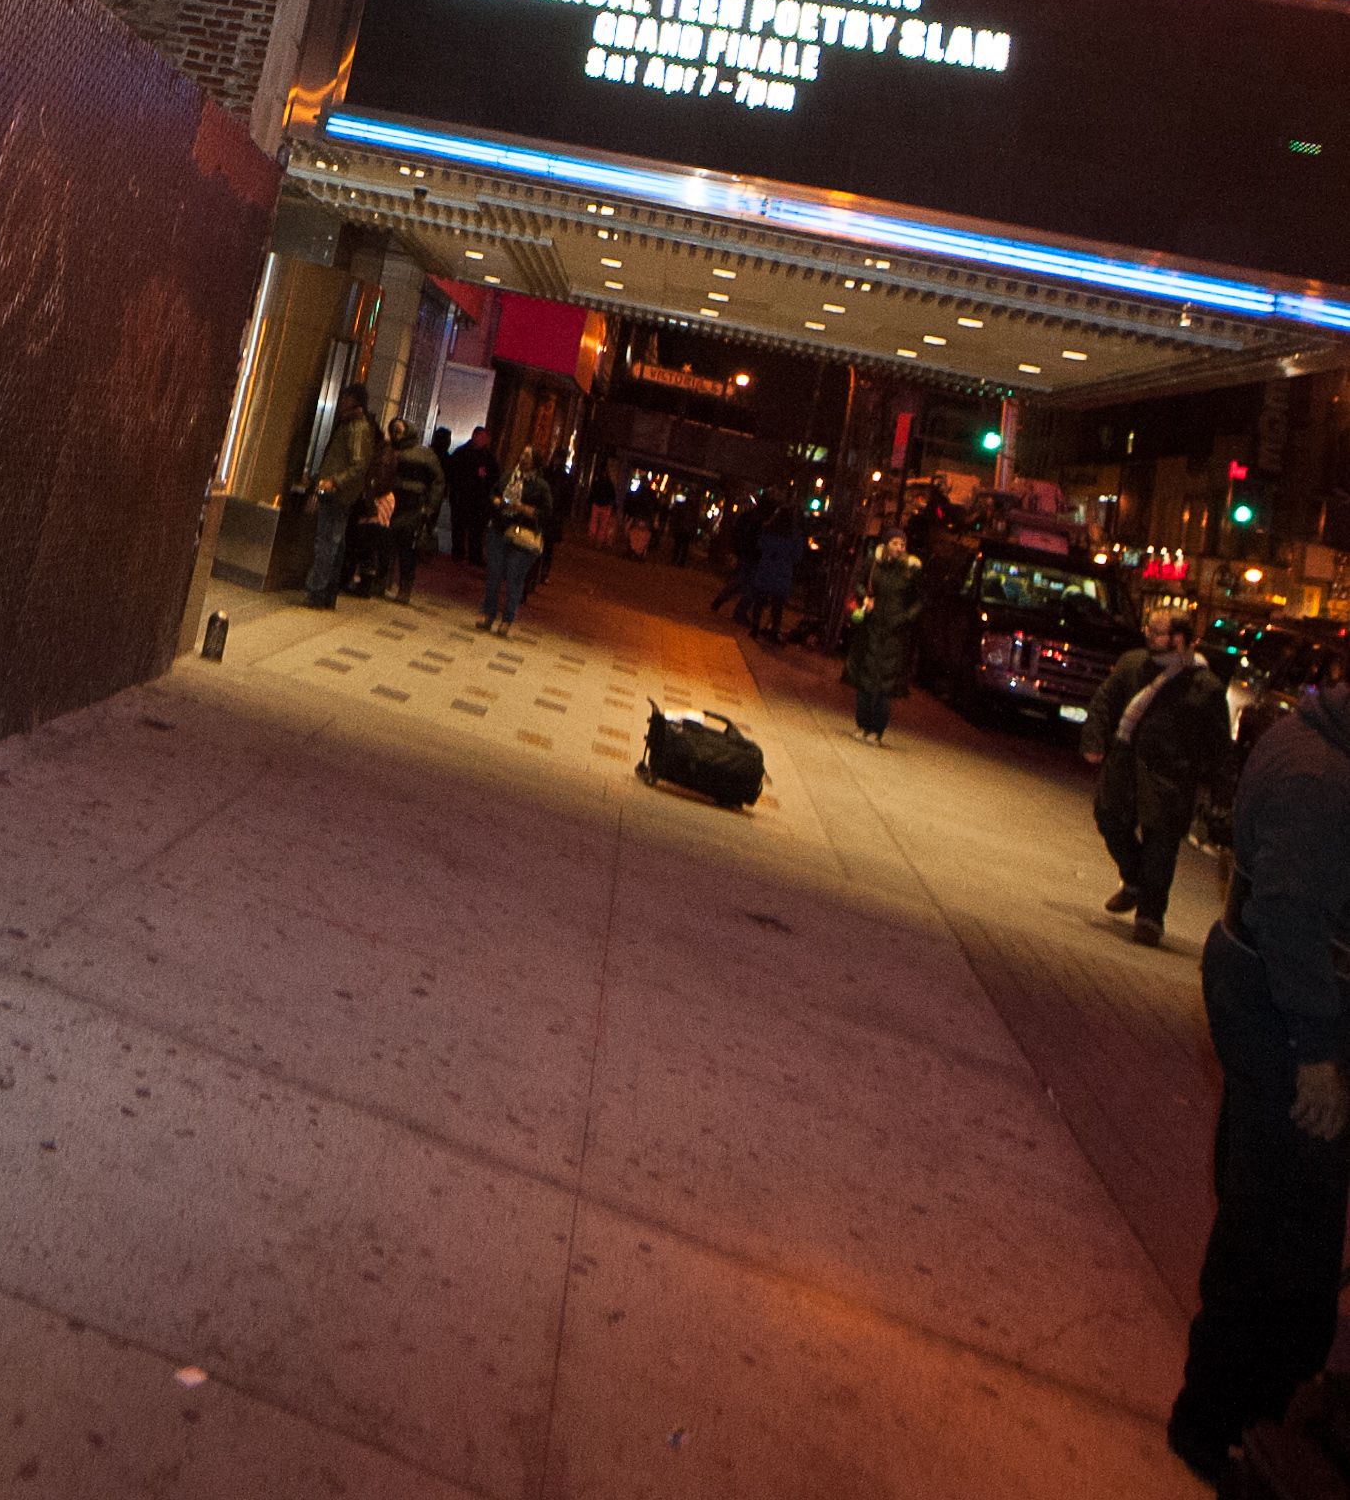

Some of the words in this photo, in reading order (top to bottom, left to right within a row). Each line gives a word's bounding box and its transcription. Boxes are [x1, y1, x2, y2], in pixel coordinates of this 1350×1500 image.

[584, 46, 638, 85] Sat
[643, 56, 699, 95] Apr
[592, 11, 704, 61] GRAND
[705, 28, 821, 82] FINALE
[898, 18, 1011, 73] SLAM
